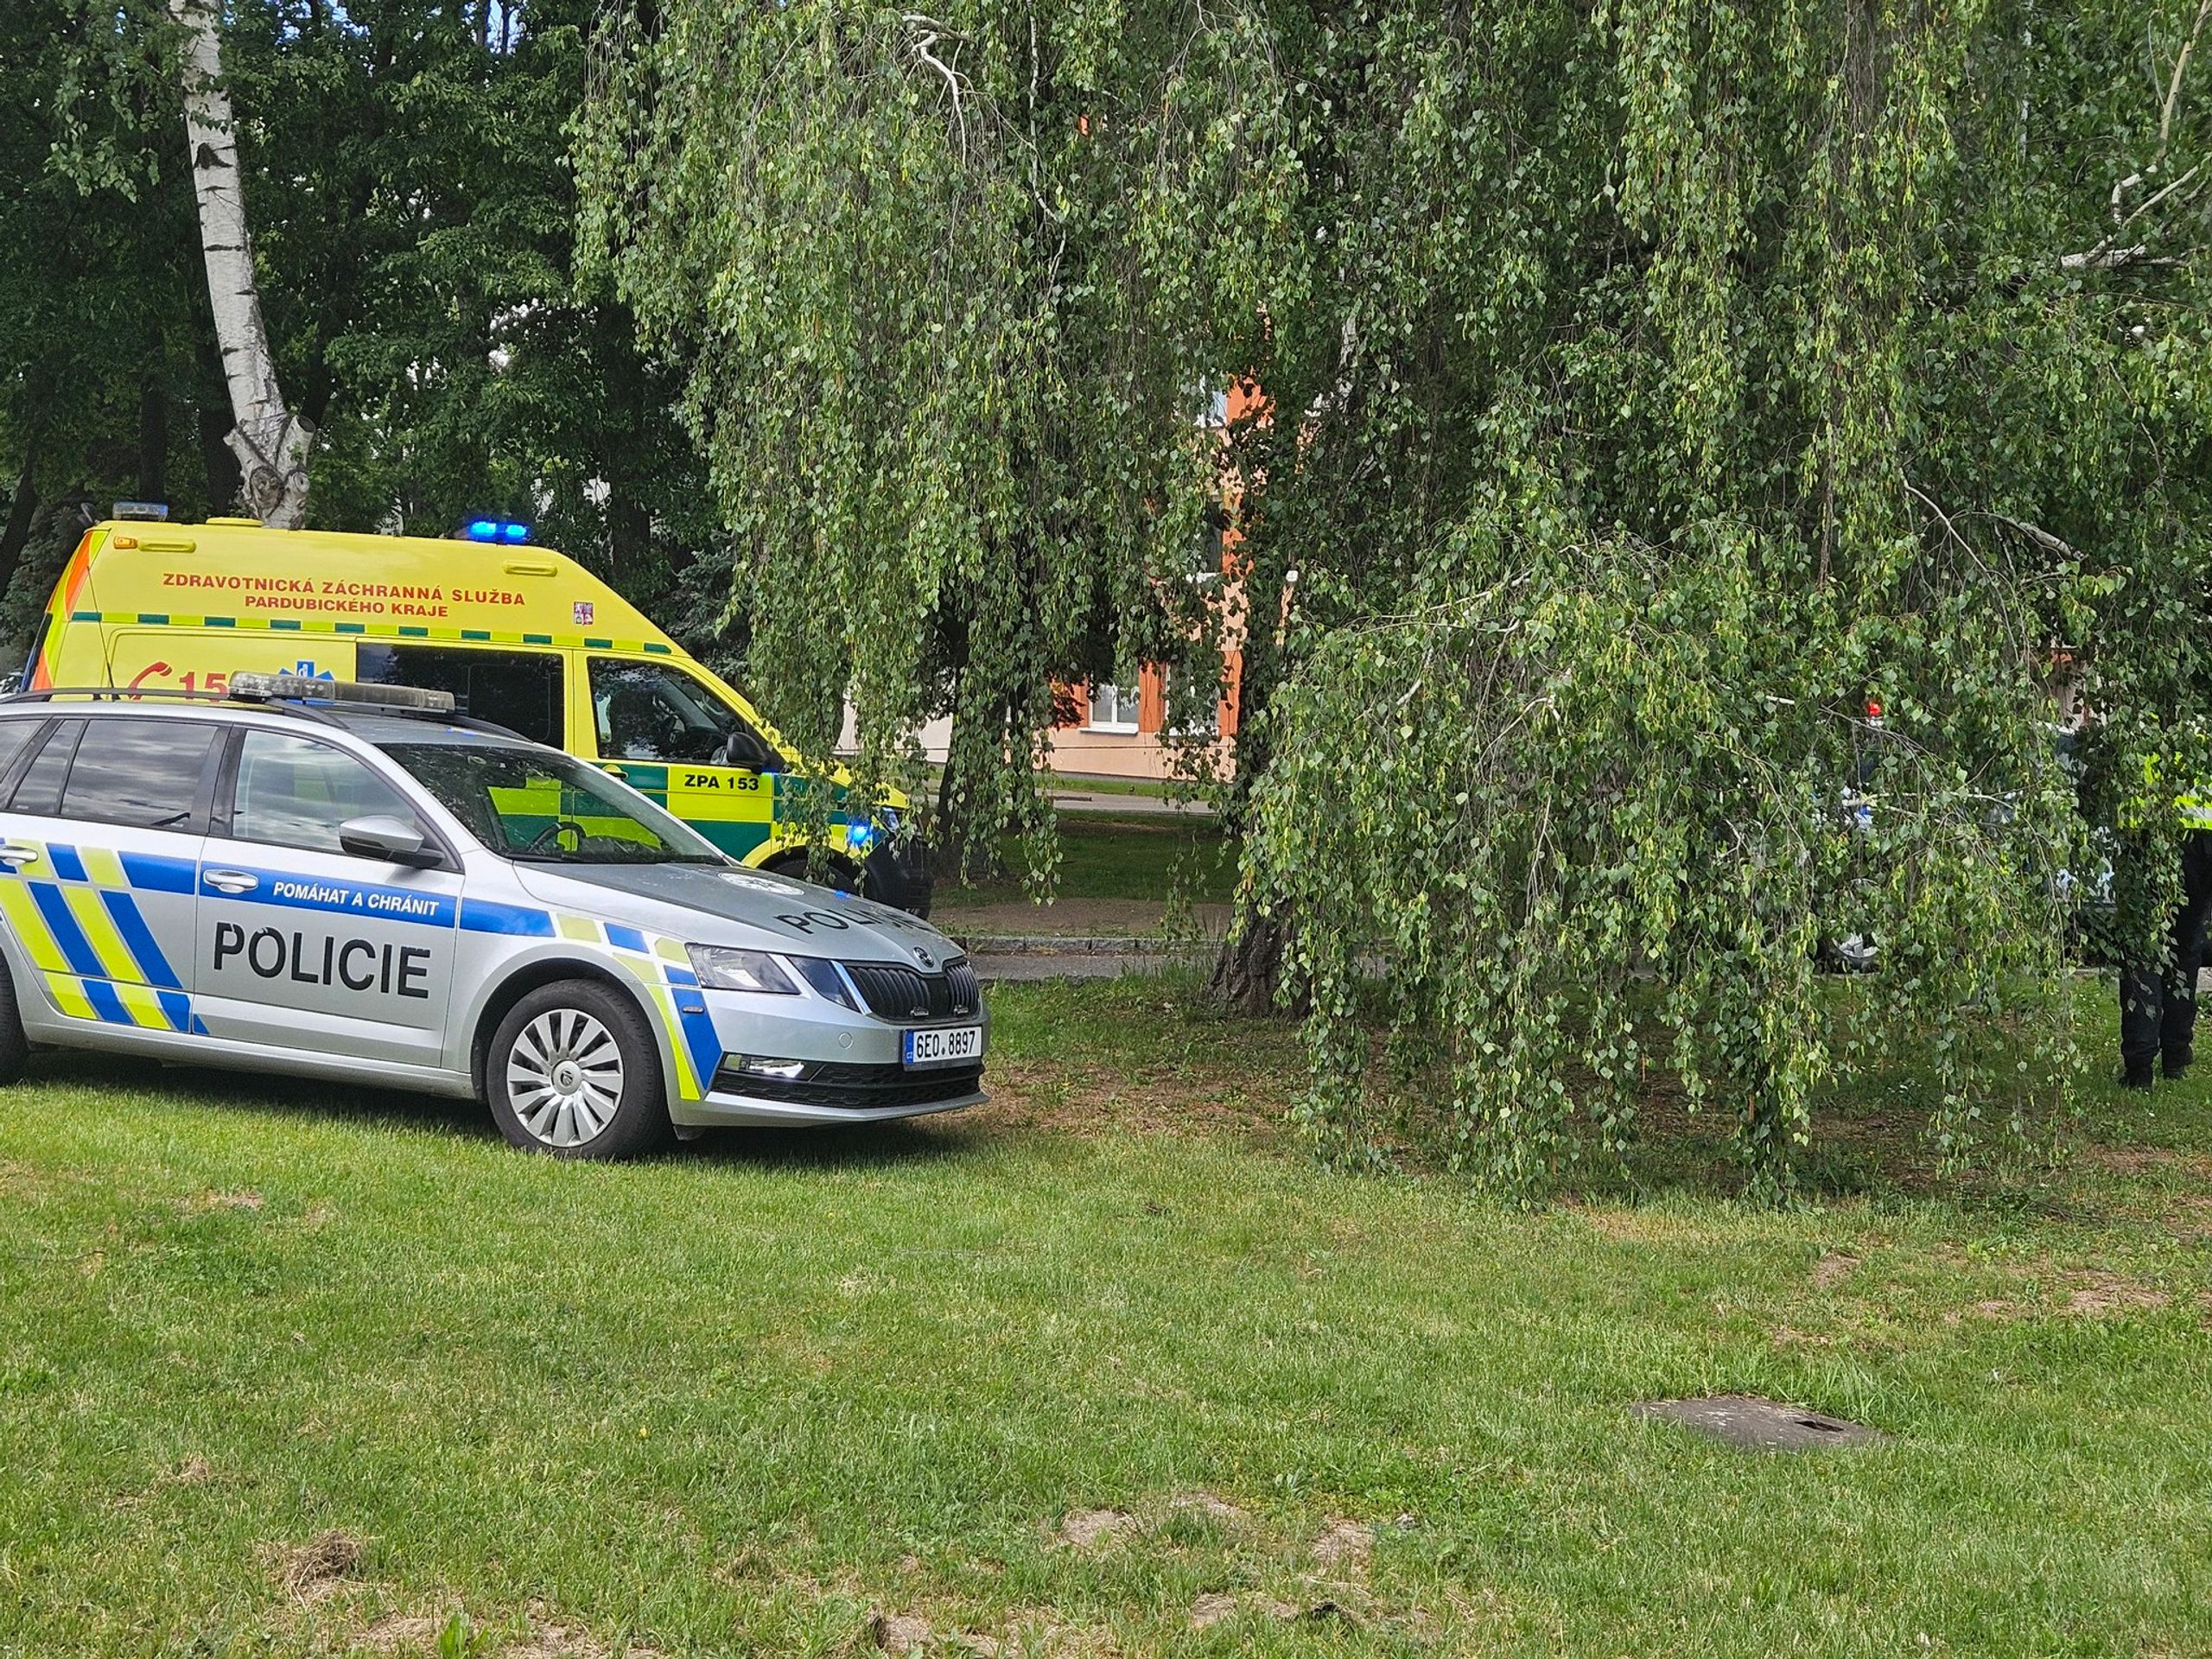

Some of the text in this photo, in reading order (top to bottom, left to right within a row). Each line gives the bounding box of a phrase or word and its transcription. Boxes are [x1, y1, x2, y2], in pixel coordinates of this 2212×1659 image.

[162, 573, 525, 606] ZDRAVOTNICKÁ ZÁCHRANNÁ SLUŽBA
[245, 595, 448, 617] PARDUBICKÉHO KRAJE
[684, 773, 760, 791] ZPA 153
[273, 881, 440, 917] POMÁHAT A CHRÁNIT
[772, 907, 934, 935] POLI
[213, 921, 431, 999] POLICIE
